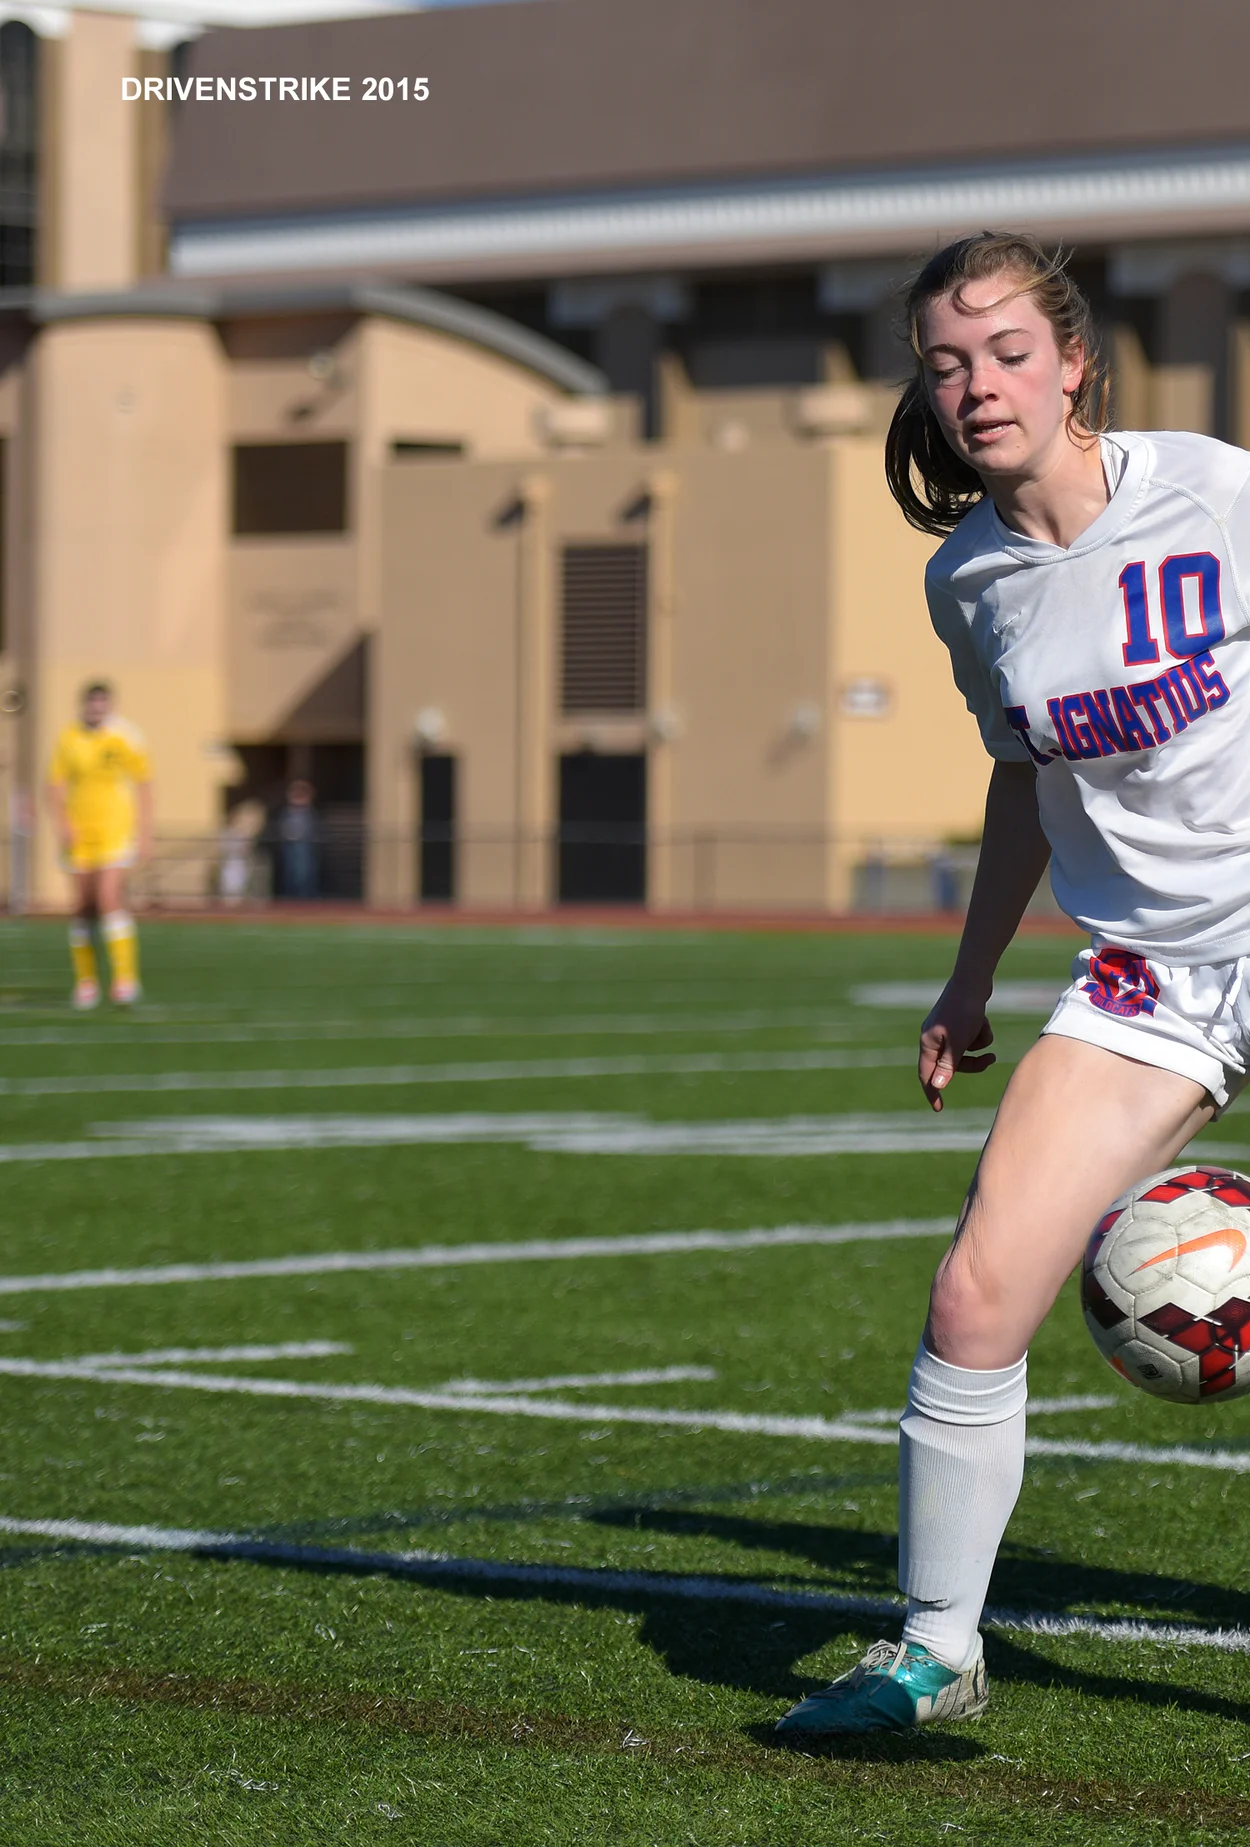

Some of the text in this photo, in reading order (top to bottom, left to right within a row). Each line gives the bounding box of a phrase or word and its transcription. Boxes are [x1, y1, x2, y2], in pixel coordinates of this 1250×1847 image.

[1118, 551, 1226, 667] 10
[1003, 649, 1231, 767] T. IGNATIUS
[1092, 991, 1138, 1016] WILDCATS
